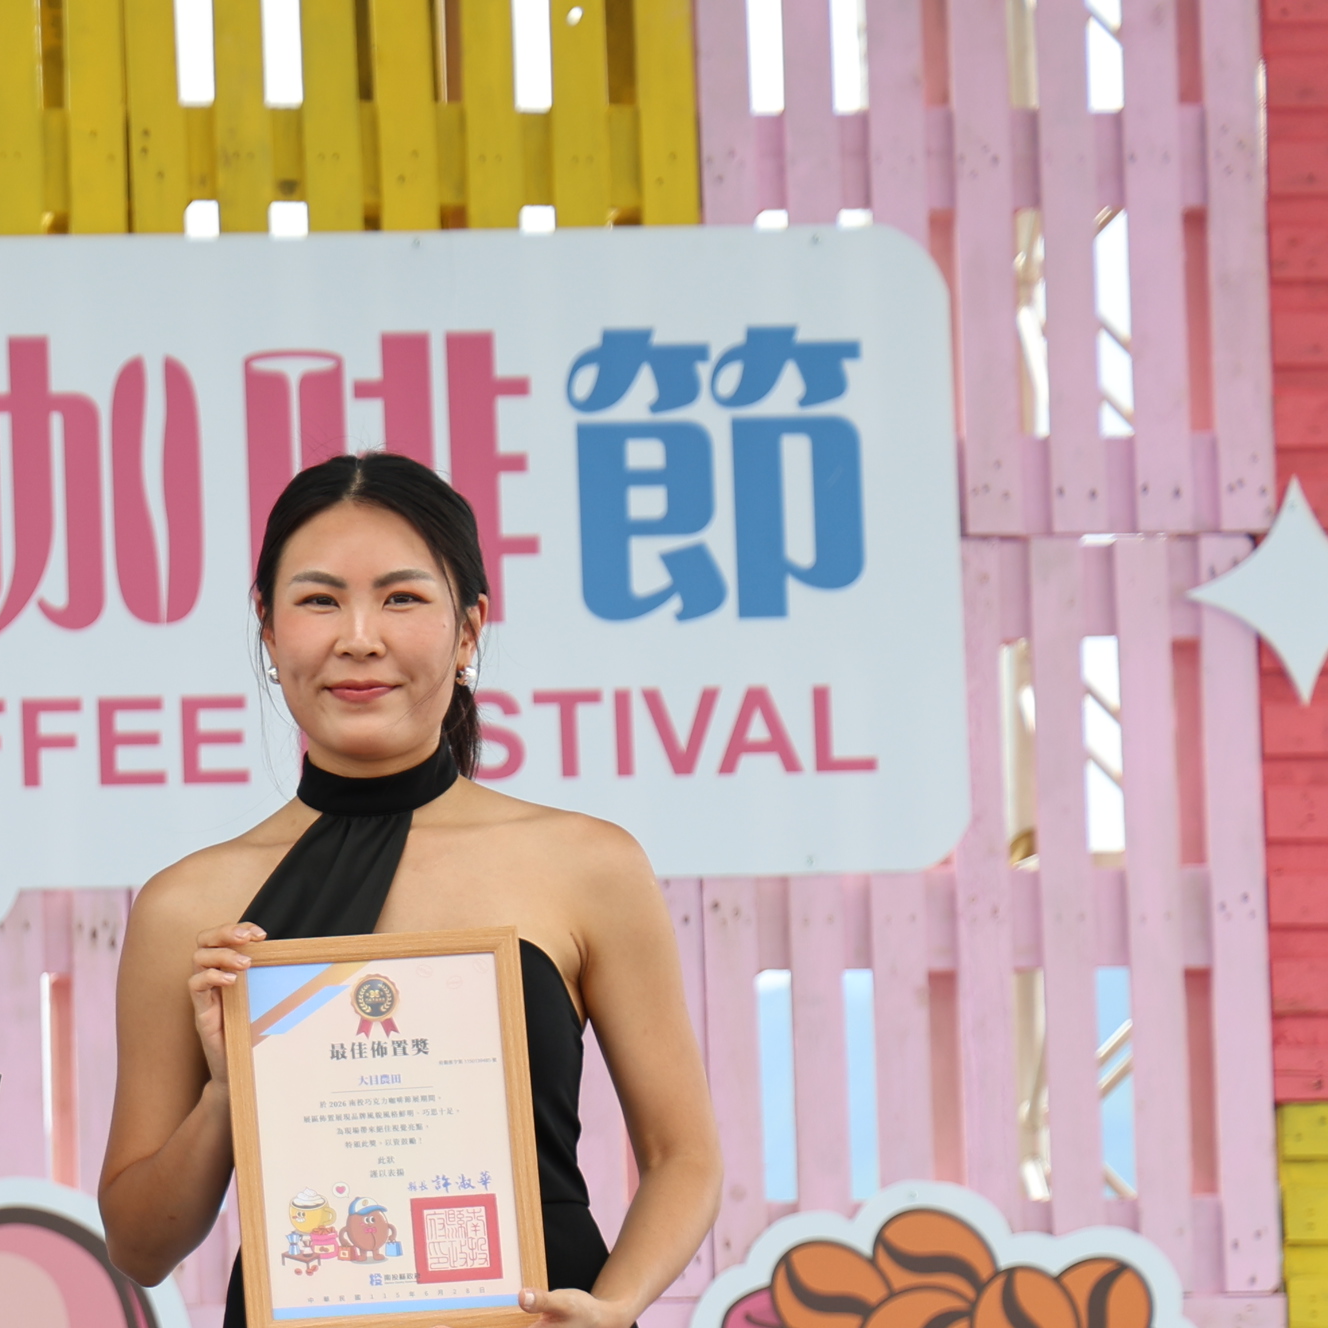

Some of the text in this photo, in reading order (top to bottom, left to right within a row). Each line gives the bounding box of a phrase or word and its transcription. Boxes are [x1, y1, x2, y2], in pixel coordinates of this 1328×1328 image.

[301, 685, 879, 780] STIVAL
[330, 1037, 429, 1061] 最佳佈置獎
